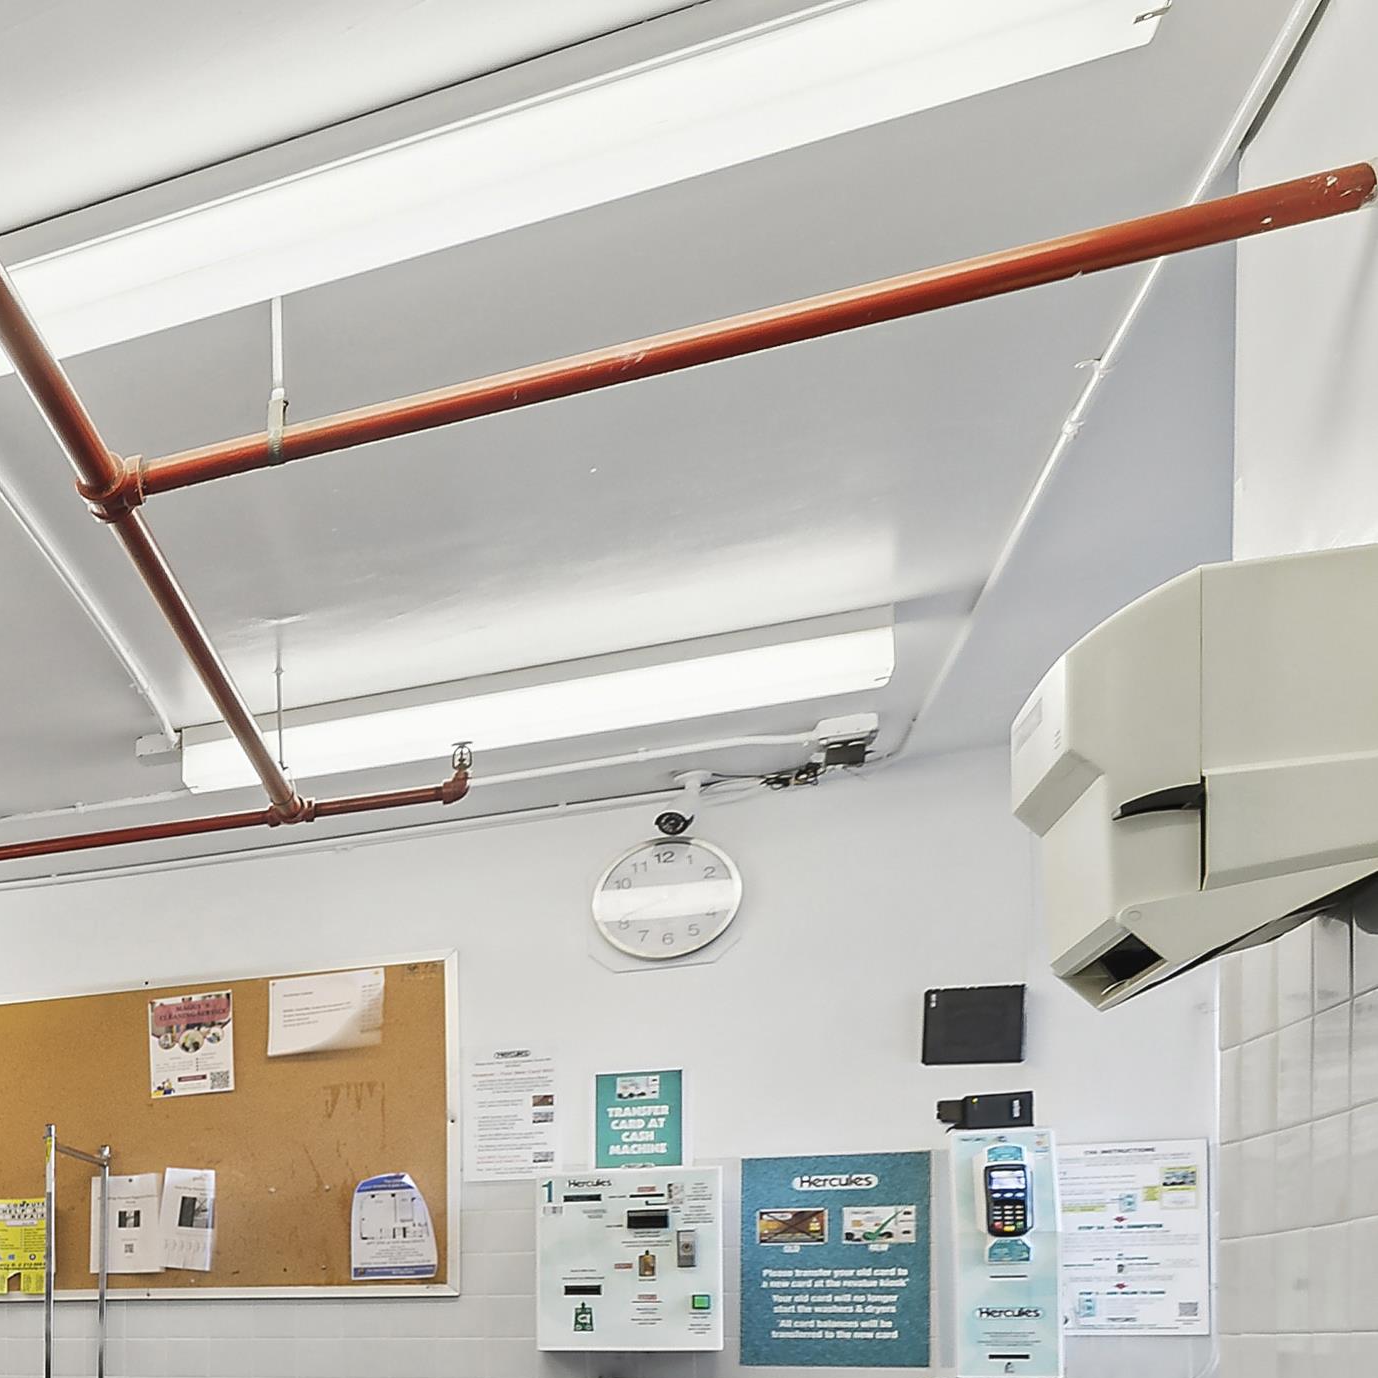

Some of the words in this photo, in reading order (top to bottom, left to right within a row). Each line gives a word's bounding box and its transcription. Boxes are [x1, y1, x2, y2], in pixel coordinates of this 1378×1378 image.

[655, 851, 675, 864] 12
[687, 855, 693, 864] 1
[632, 862, 648, 874] 11
[704, 866, 716, 879] 2
[615, 877, 631, 890] 10
[638, 930, 649, 942] 7
[688, 924, 700, 937] 5
[662, 932, 674, 945] 6
[607, 1105, 669, 1118] TRANSFER
[611, 1120, 644, 1130] CARD
[648, 1118, 666, 1128] AT
[621, 1131, 654, 1142] CASH
[609, 1143, 667, 1155] MACHINE
[800, 1175, 872, 1188] Hercules
[542, 1180, 553, 1203] 1
[568, 1179, 612, 1187] Hercules
[978, 1306, 1040, 1318] Hercules
